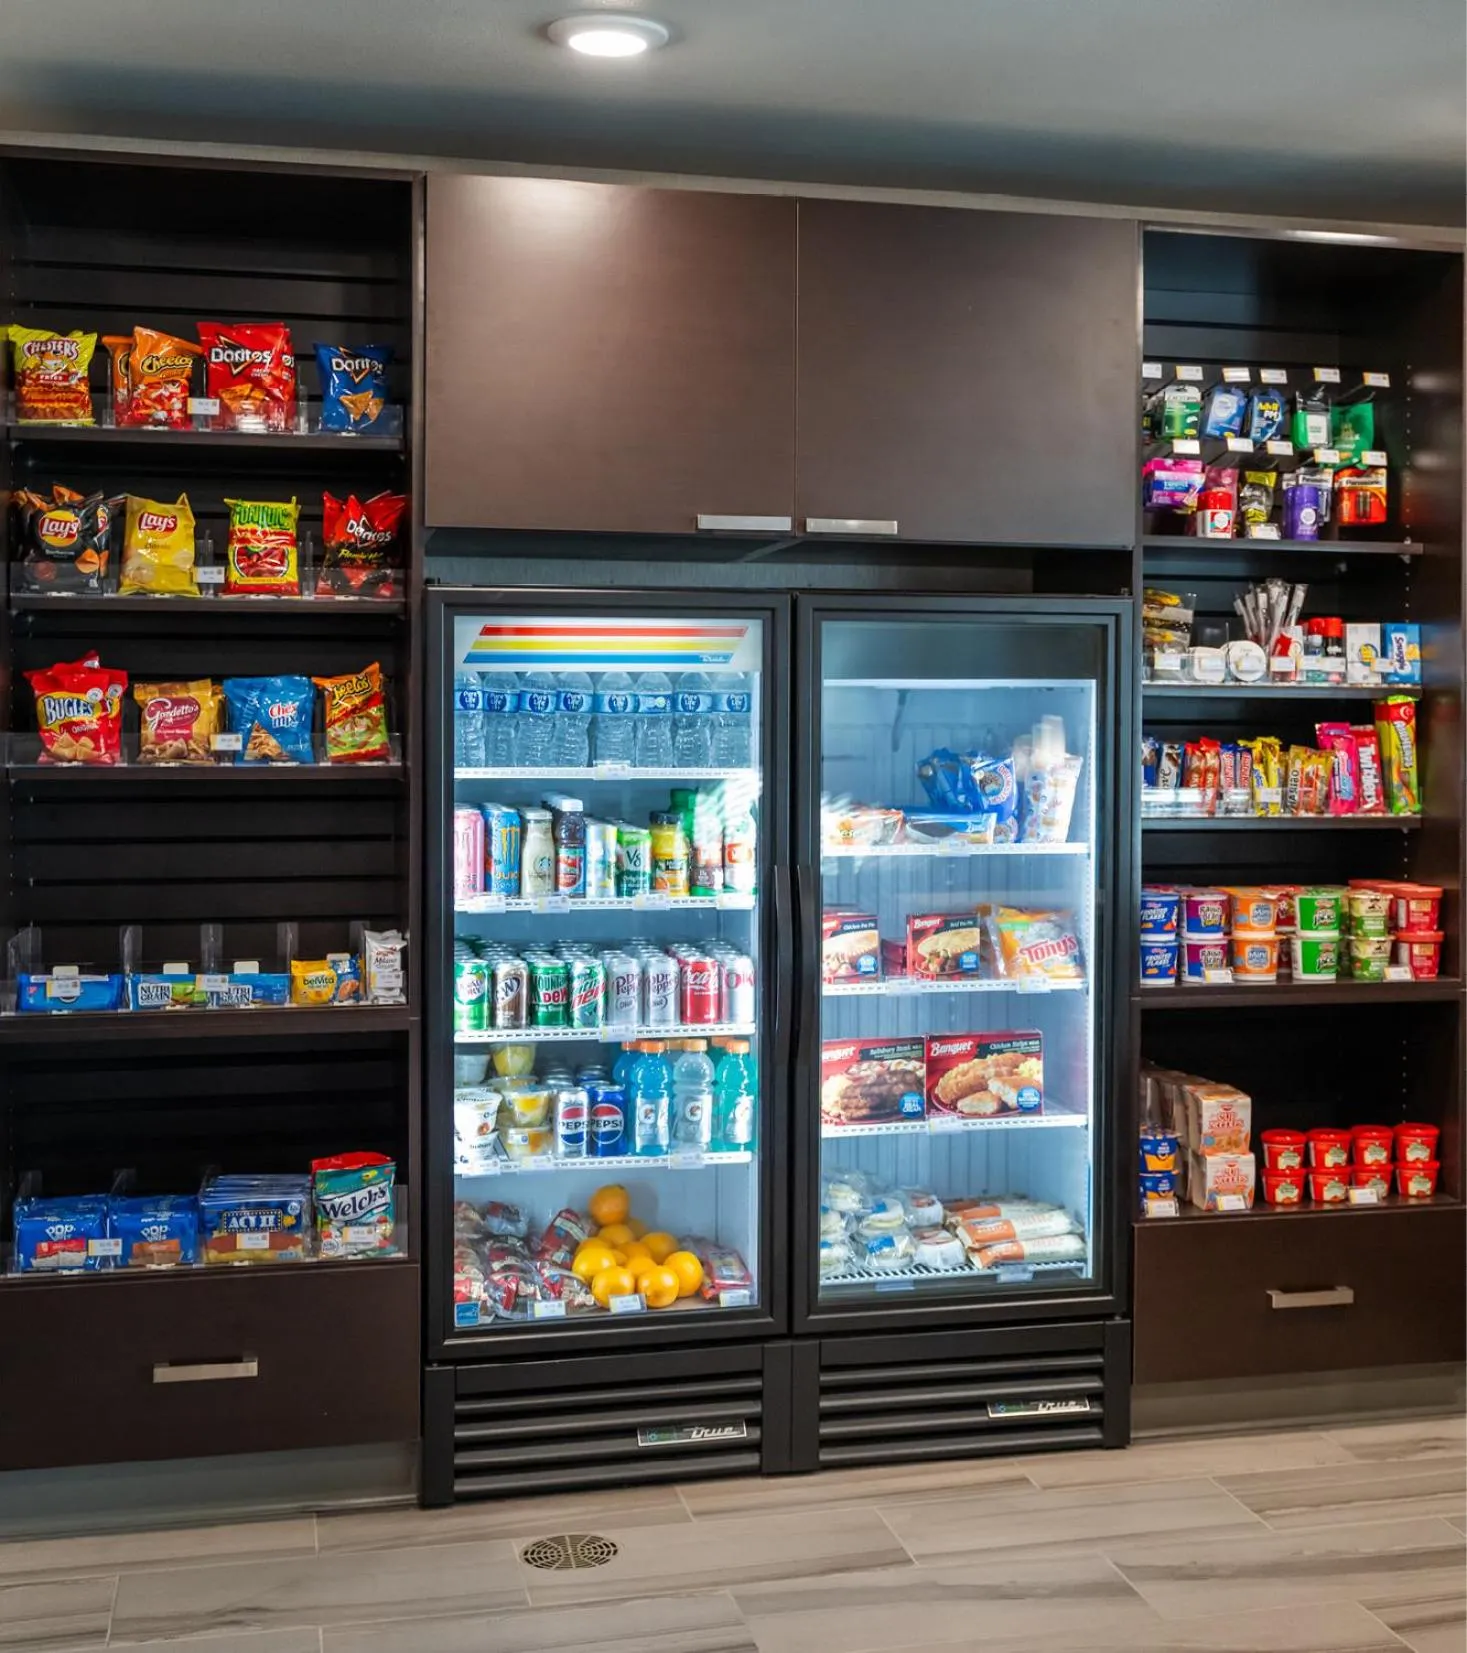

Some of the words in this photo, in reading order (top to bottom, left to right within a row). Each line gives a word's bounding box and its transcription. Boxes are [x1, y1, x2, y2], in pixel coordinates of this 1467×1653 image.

[211, 348, 272, 364] Doritos
[44, 697, 93, 725] BUGLES
[1019, 934, 1077, 965] Tony's
[931, 1040, 974, 1057] Banquet
[322, 1186, 388, 1220] Welch's
[228, 1215, 256, 1228] ACT
